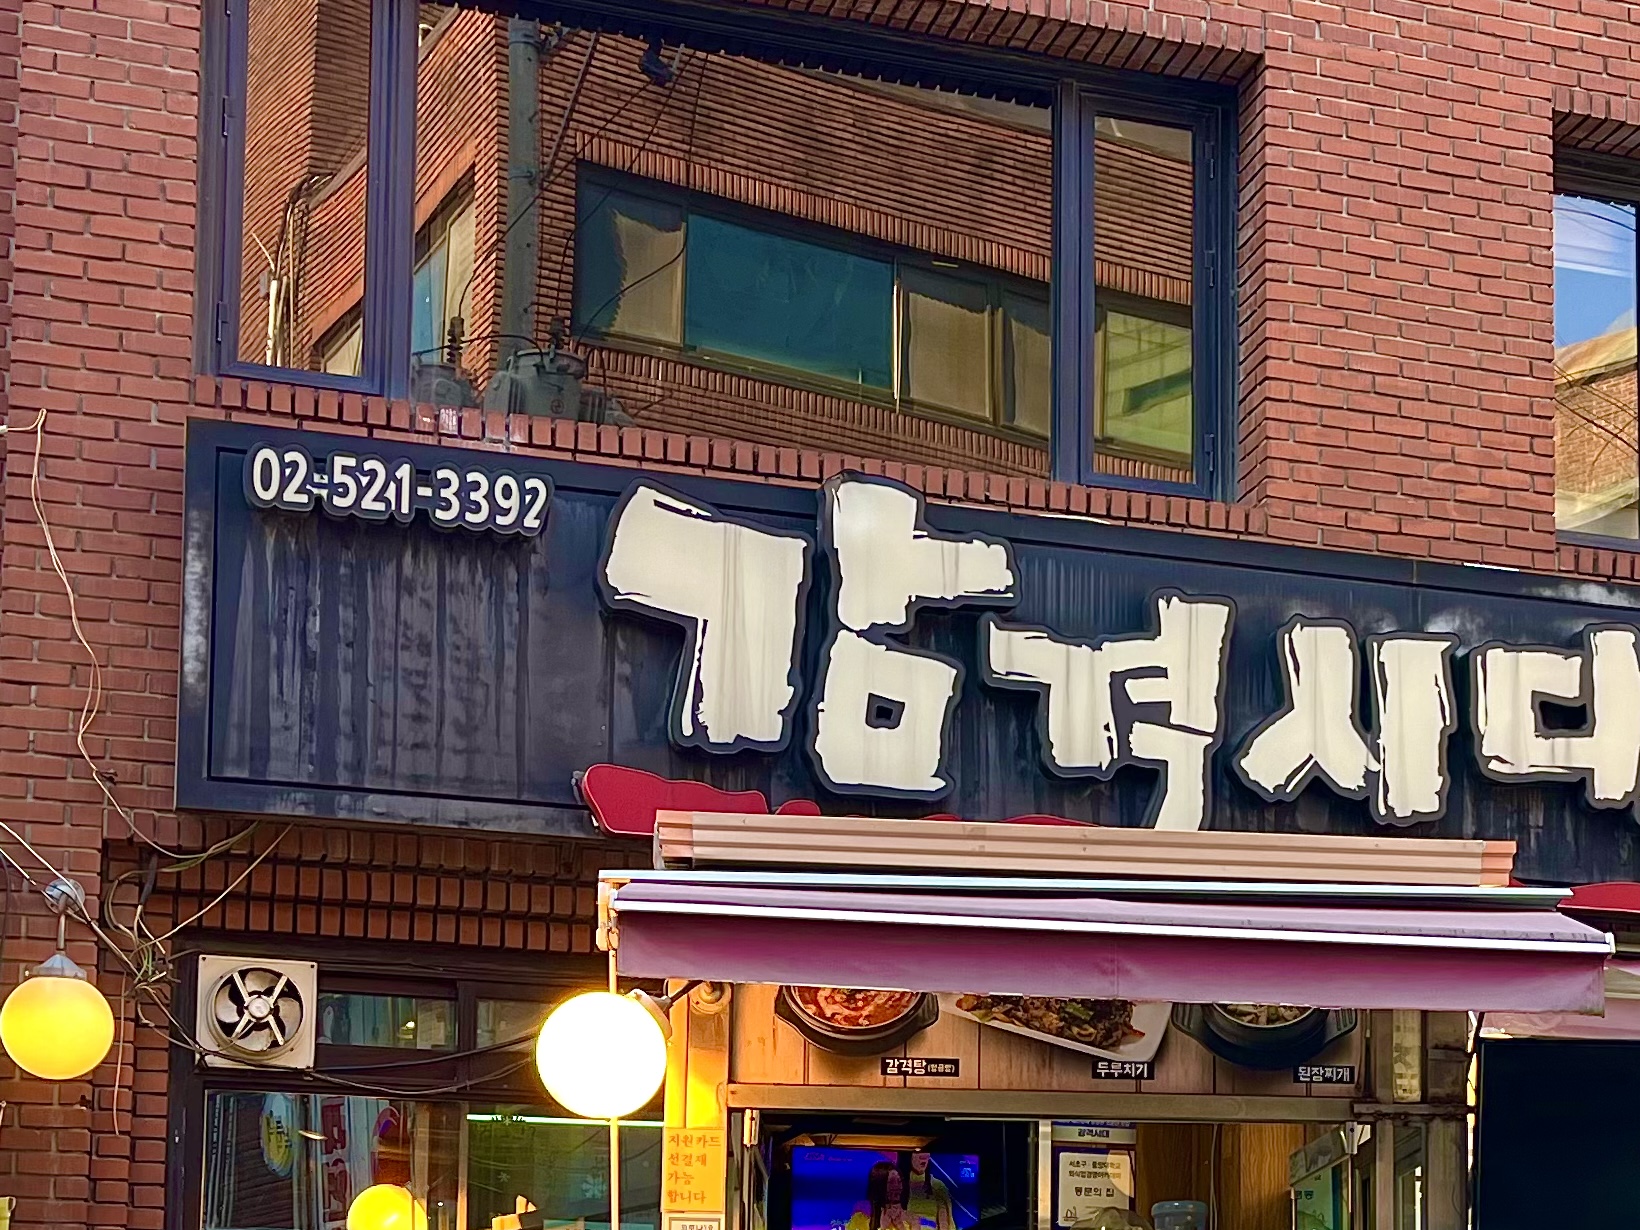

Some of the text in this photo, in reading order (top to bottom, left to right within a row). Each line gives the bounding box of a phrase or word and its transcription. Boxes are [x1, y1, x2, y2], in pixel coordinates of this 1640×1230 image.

[252, 446, 549, 530] 02-521-3392
[885, 1058, 927, 1075] 감격탕
[1096, 1062, 1150, 1079] 두루치기
[1297, 1065, 1354, 1082] 된장찌개
